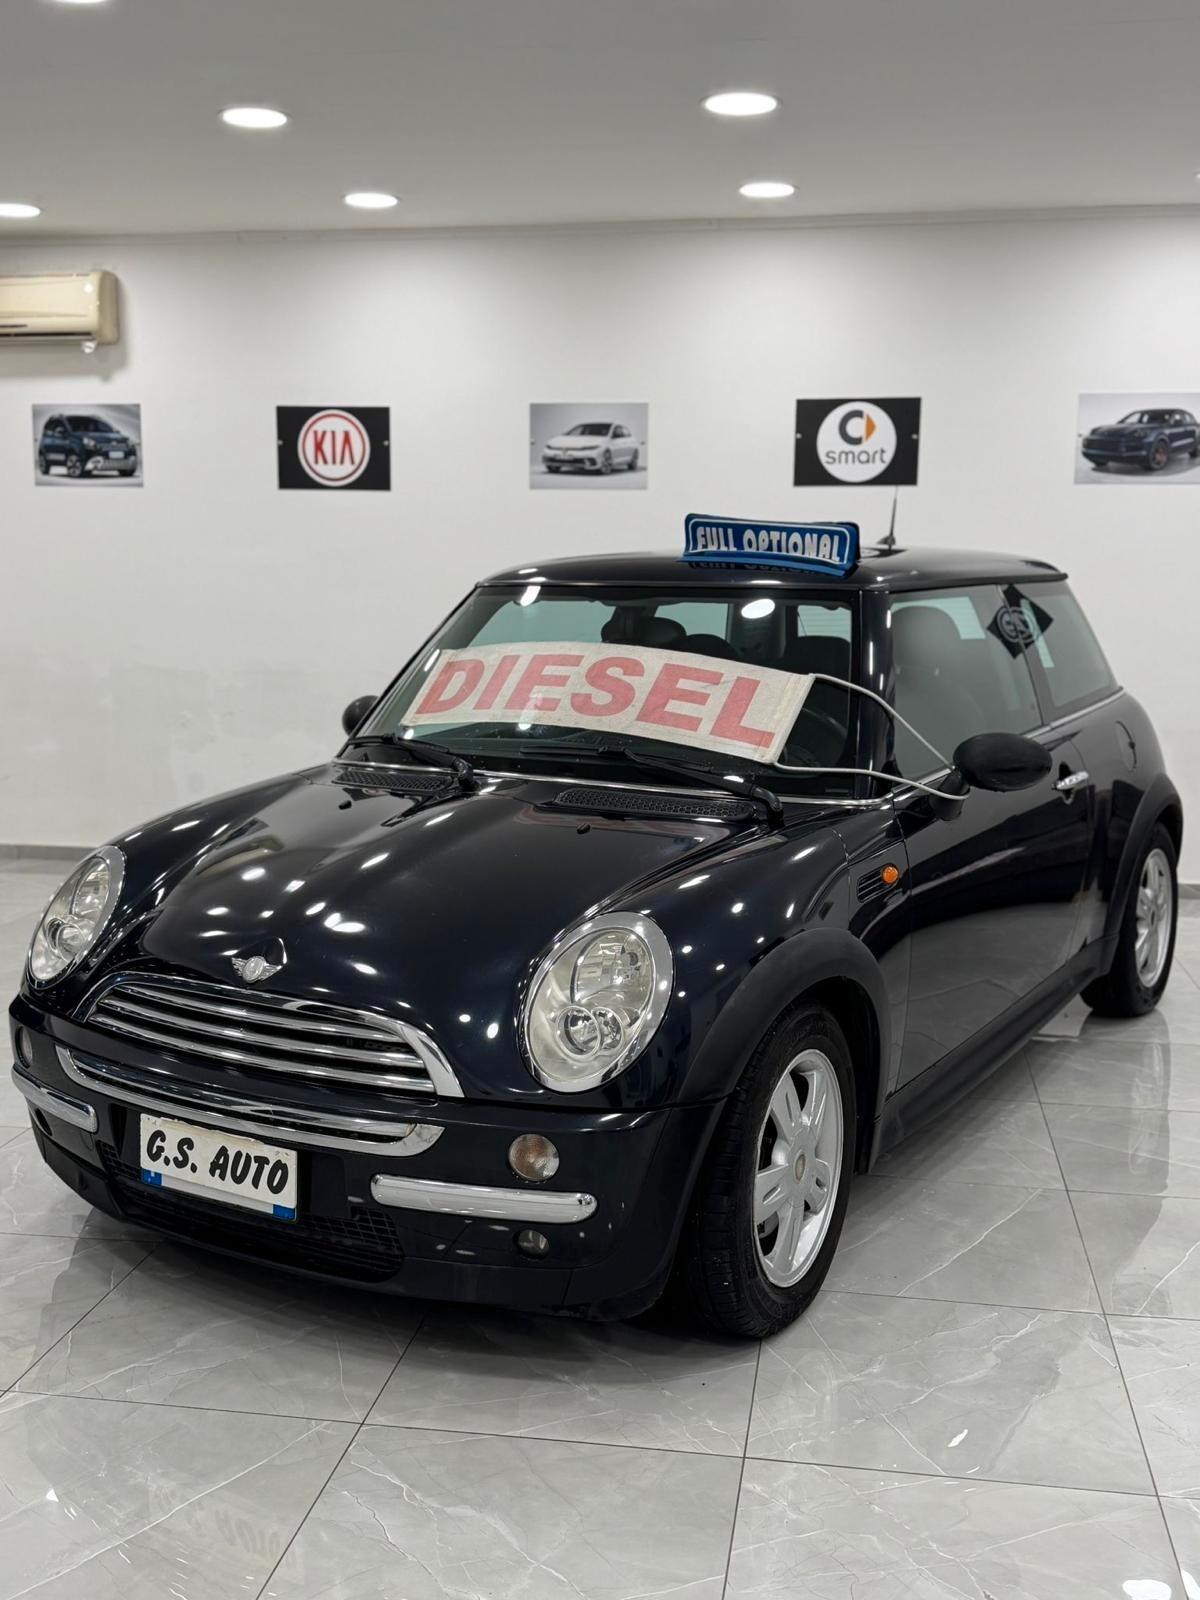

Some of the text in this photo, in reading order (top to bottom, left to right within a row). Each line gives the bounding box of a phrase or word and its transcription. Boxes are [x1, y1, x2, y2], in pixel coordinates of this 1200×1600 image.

[313, 430, 355, 465] KIA
[824, 448, 887, 465] smart
[696, 526, 841, 562] FULL OPTIONAL
[415, 653, 776, 749] DIESEL
[146, 1129, 289, 1195] G.S. AUTO
